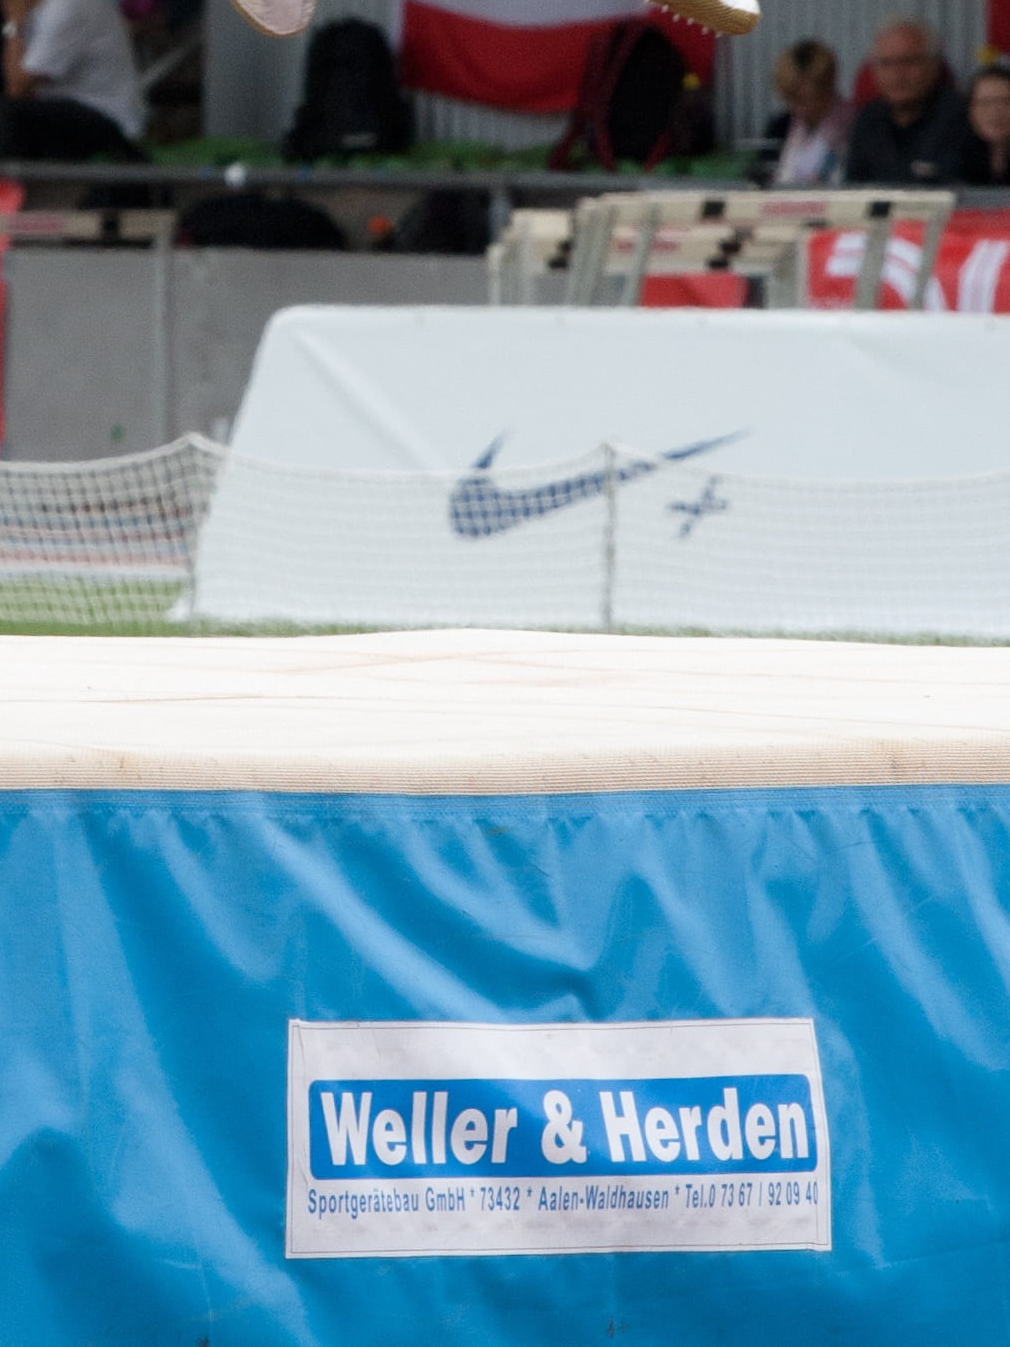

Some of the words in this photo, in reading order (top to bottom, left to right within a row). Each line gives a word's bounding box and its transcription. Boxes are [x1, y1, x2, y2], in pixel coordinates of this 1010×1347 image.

[320, 1091, 518, 1166] Weller
[541, 1089, 587, 1164] &
[599, 1087, 810, 1163] Herden
[308, 1187, 419, 1220] Sportgerätebau
[425, 1186, 465, 1212] GmbH
[480, 1185, 520, 1211] 73432
[538, 1184, 669, 1212] Aalen-Waldhausen
[721, 1182, 735, 1208] 73
[739, 1182, 753, 1208] 67
[768, 1181, 782, 1206] 92
[785, 1181, 800, 1206] 09
